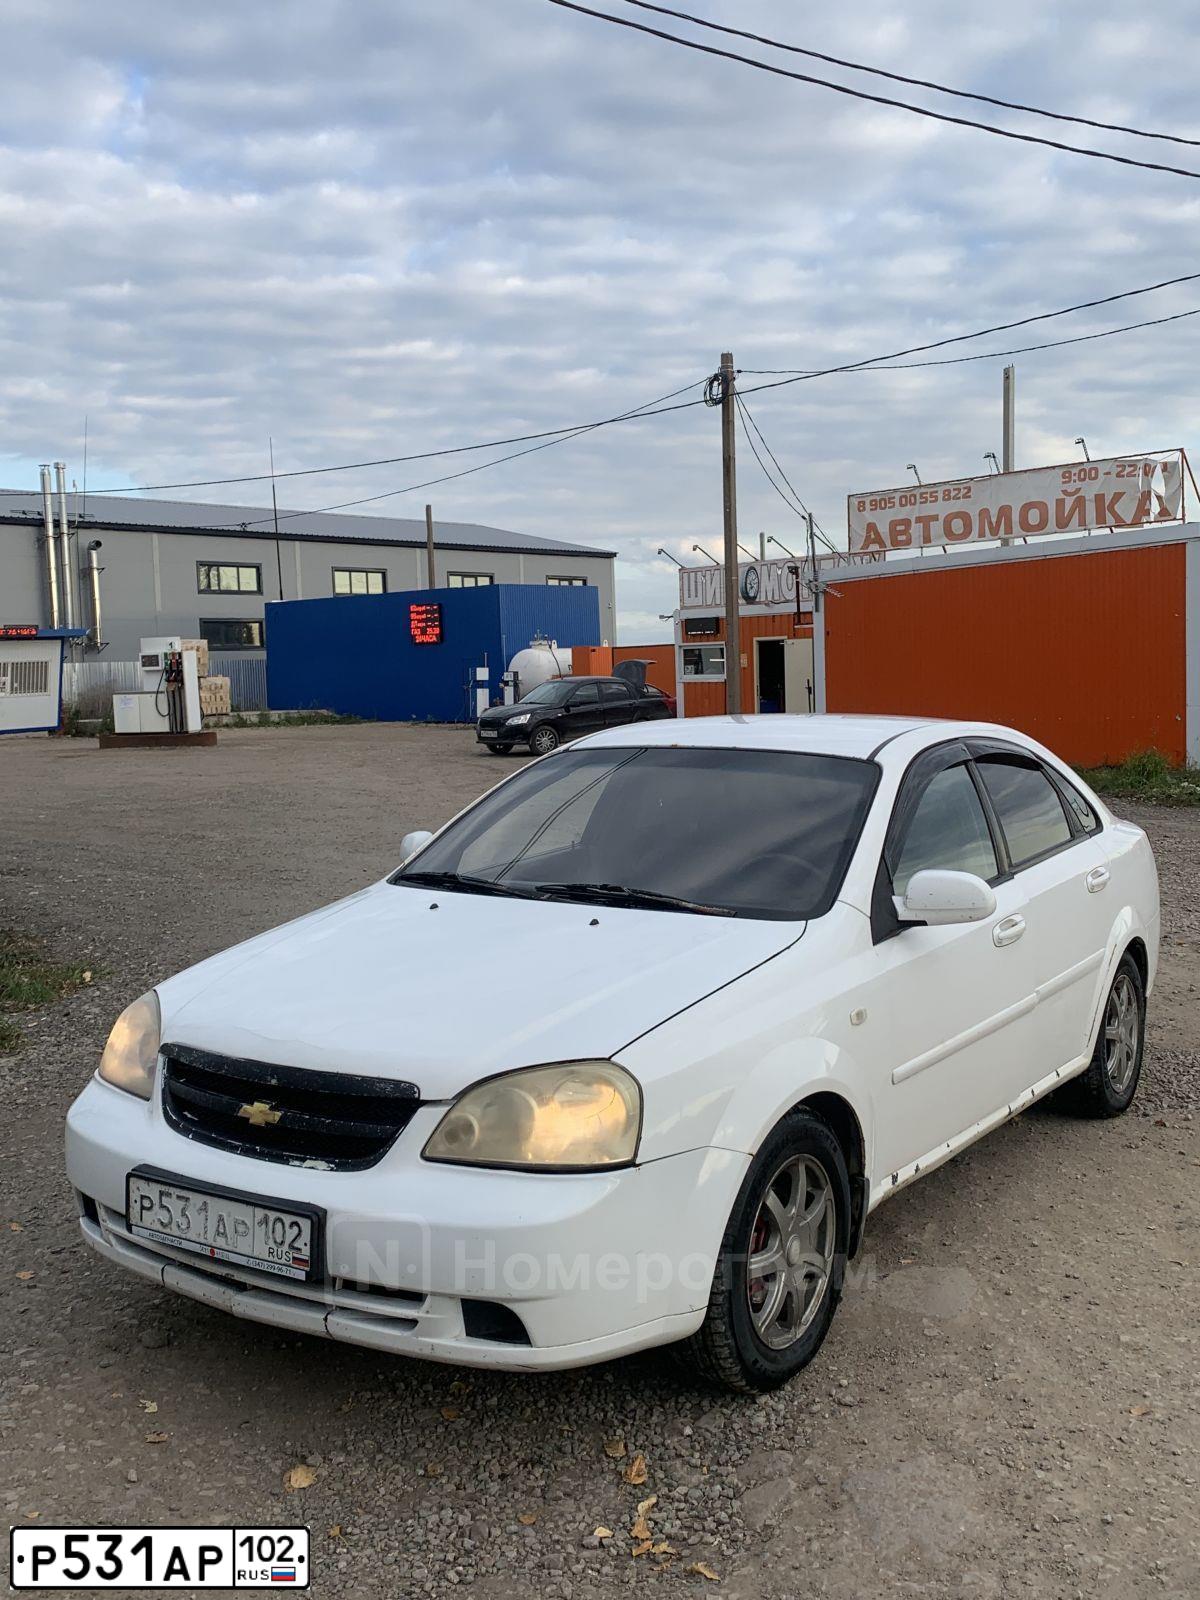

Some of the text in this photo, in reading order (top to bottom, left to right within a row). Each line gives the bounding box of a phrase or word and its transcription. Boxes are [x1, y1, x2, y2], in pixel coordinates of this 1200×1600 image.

[1061, 466, 1099, 484] 9:00
[857, 486, 972, 513] 8 905 00 55 822
[139, 1189, 303, 1252] Р531АР 102
[268, 1246, 292, 1263] RUS
